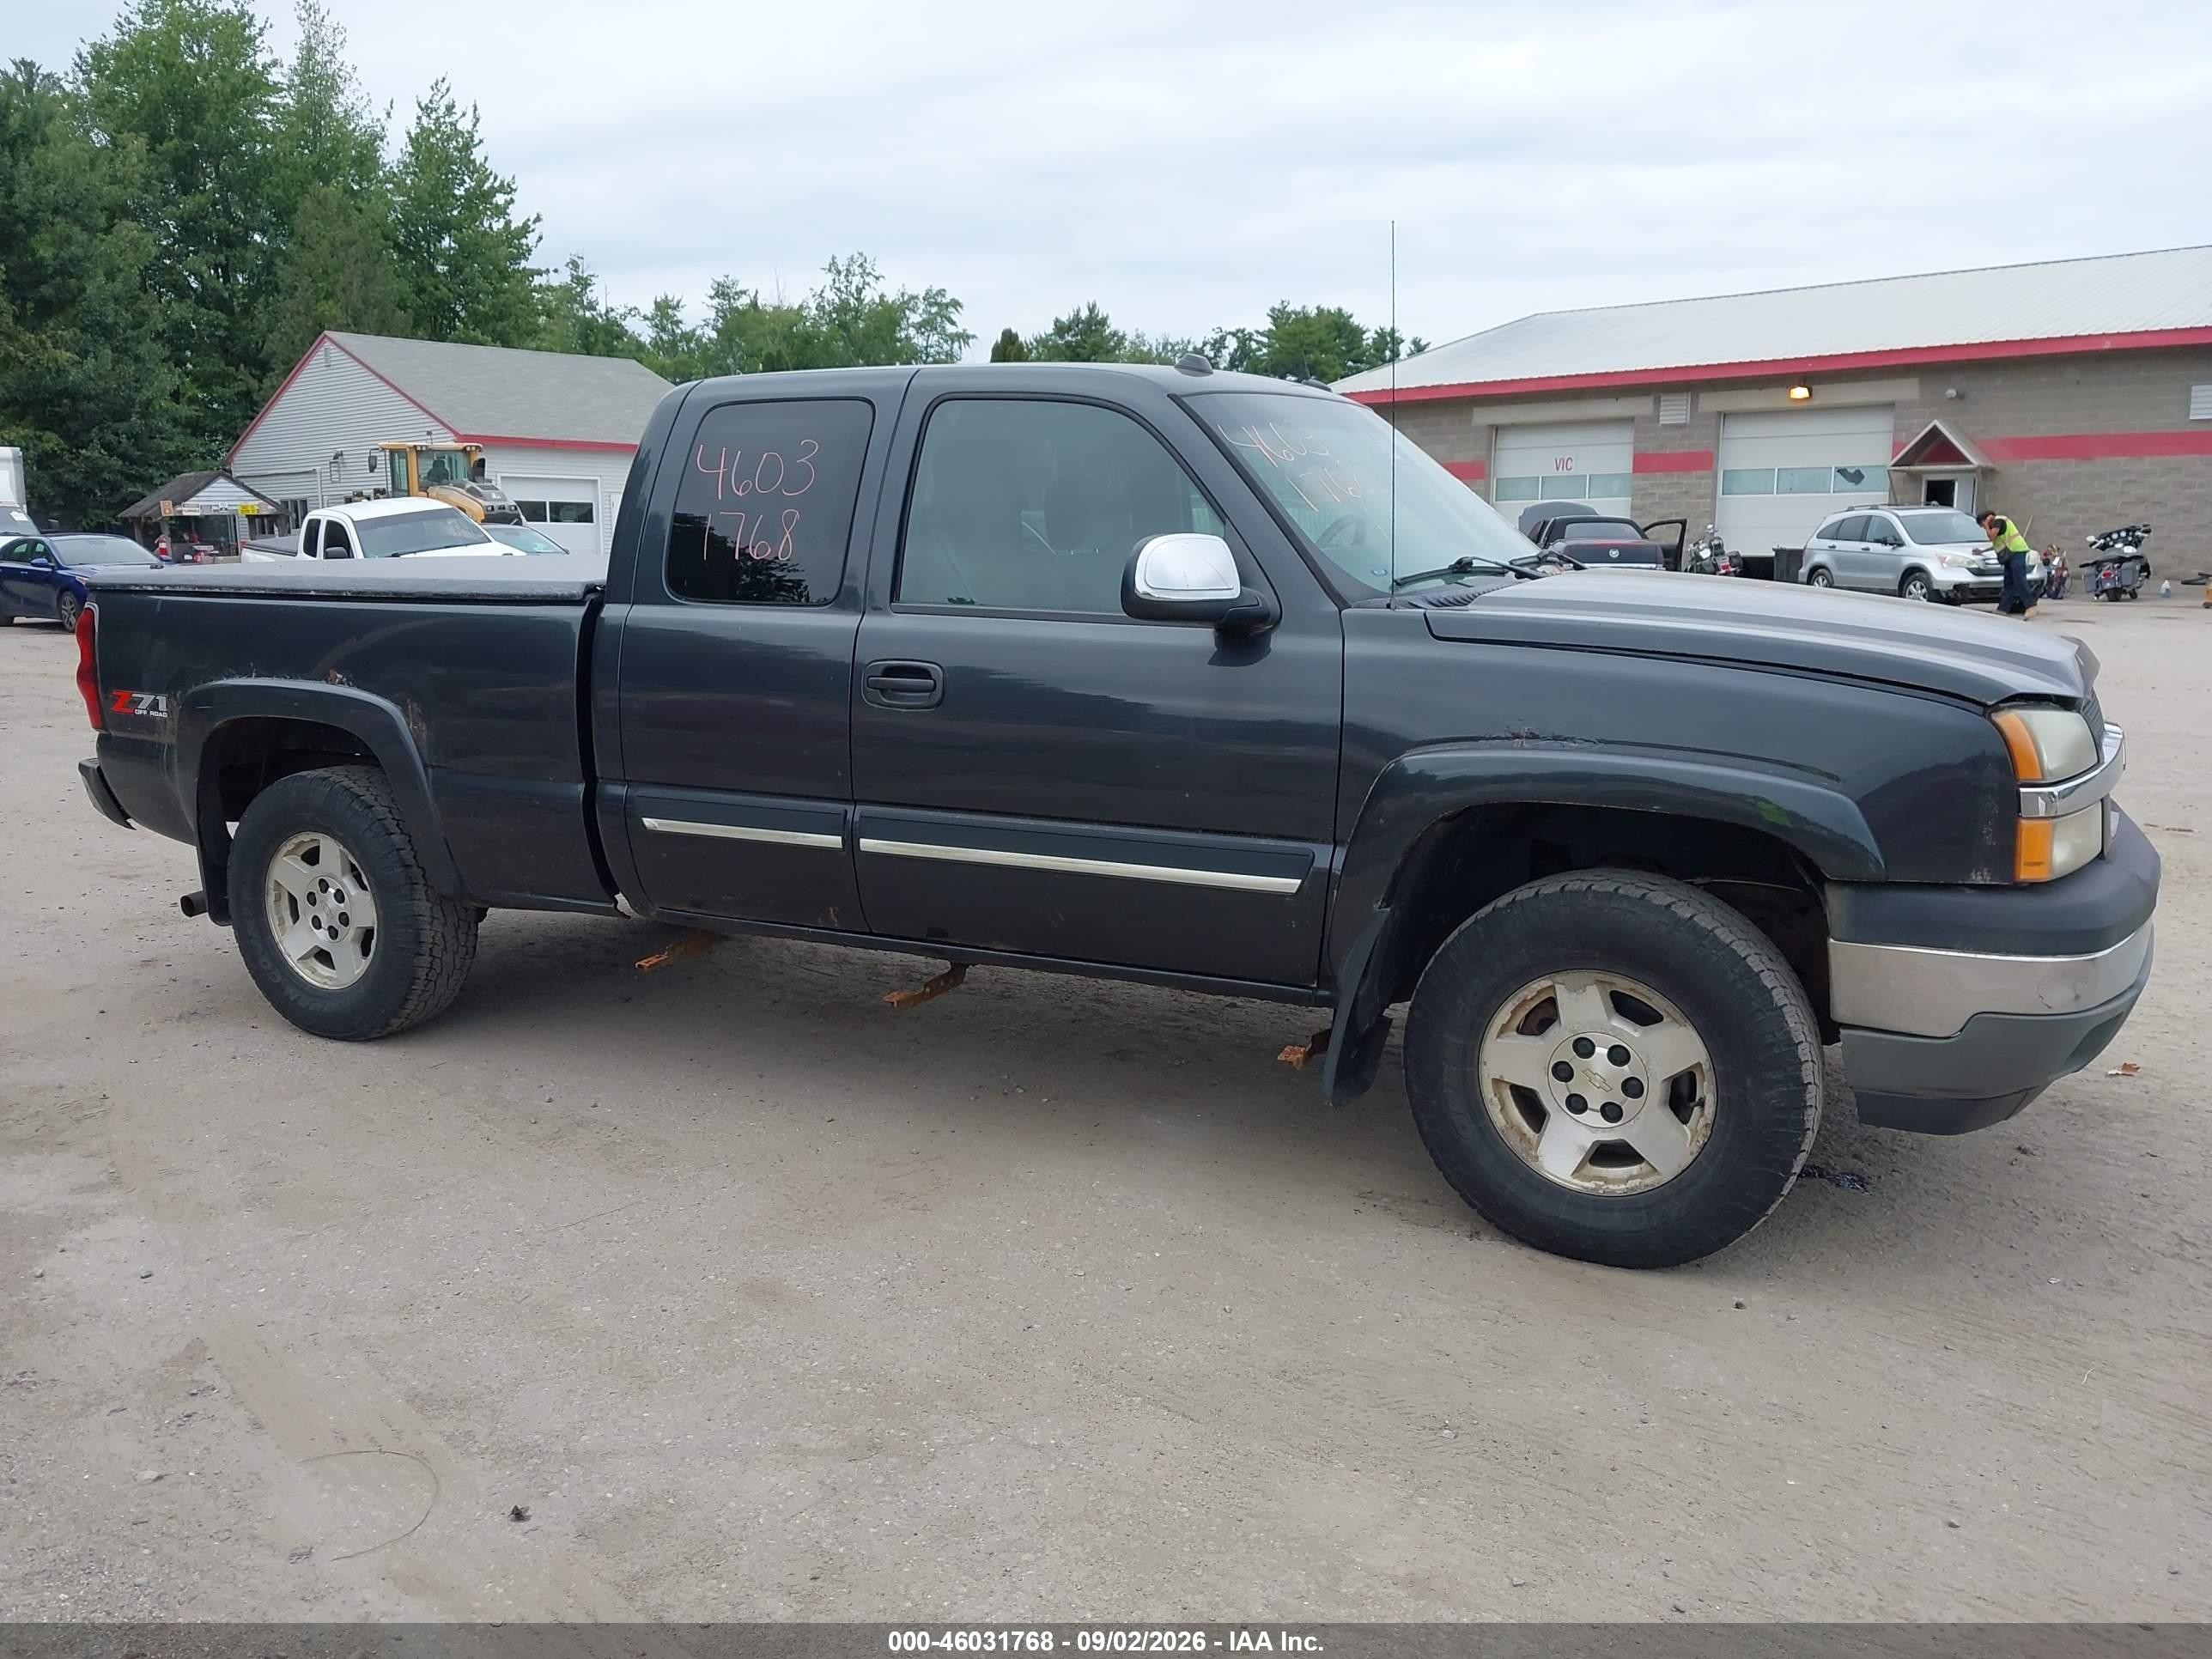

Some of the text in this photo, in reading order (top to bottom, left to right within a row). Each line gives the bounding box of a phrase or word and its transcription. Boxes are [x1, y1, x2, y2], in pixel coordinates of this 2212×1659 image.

[696, 439, 819, 500] 4603
[1286, 461, 1362, 513] 176
[1553, 456, 1573, 471] VIC
[702, 508, 800, 561] 1768
[112, 690, 167, 713] Z71
